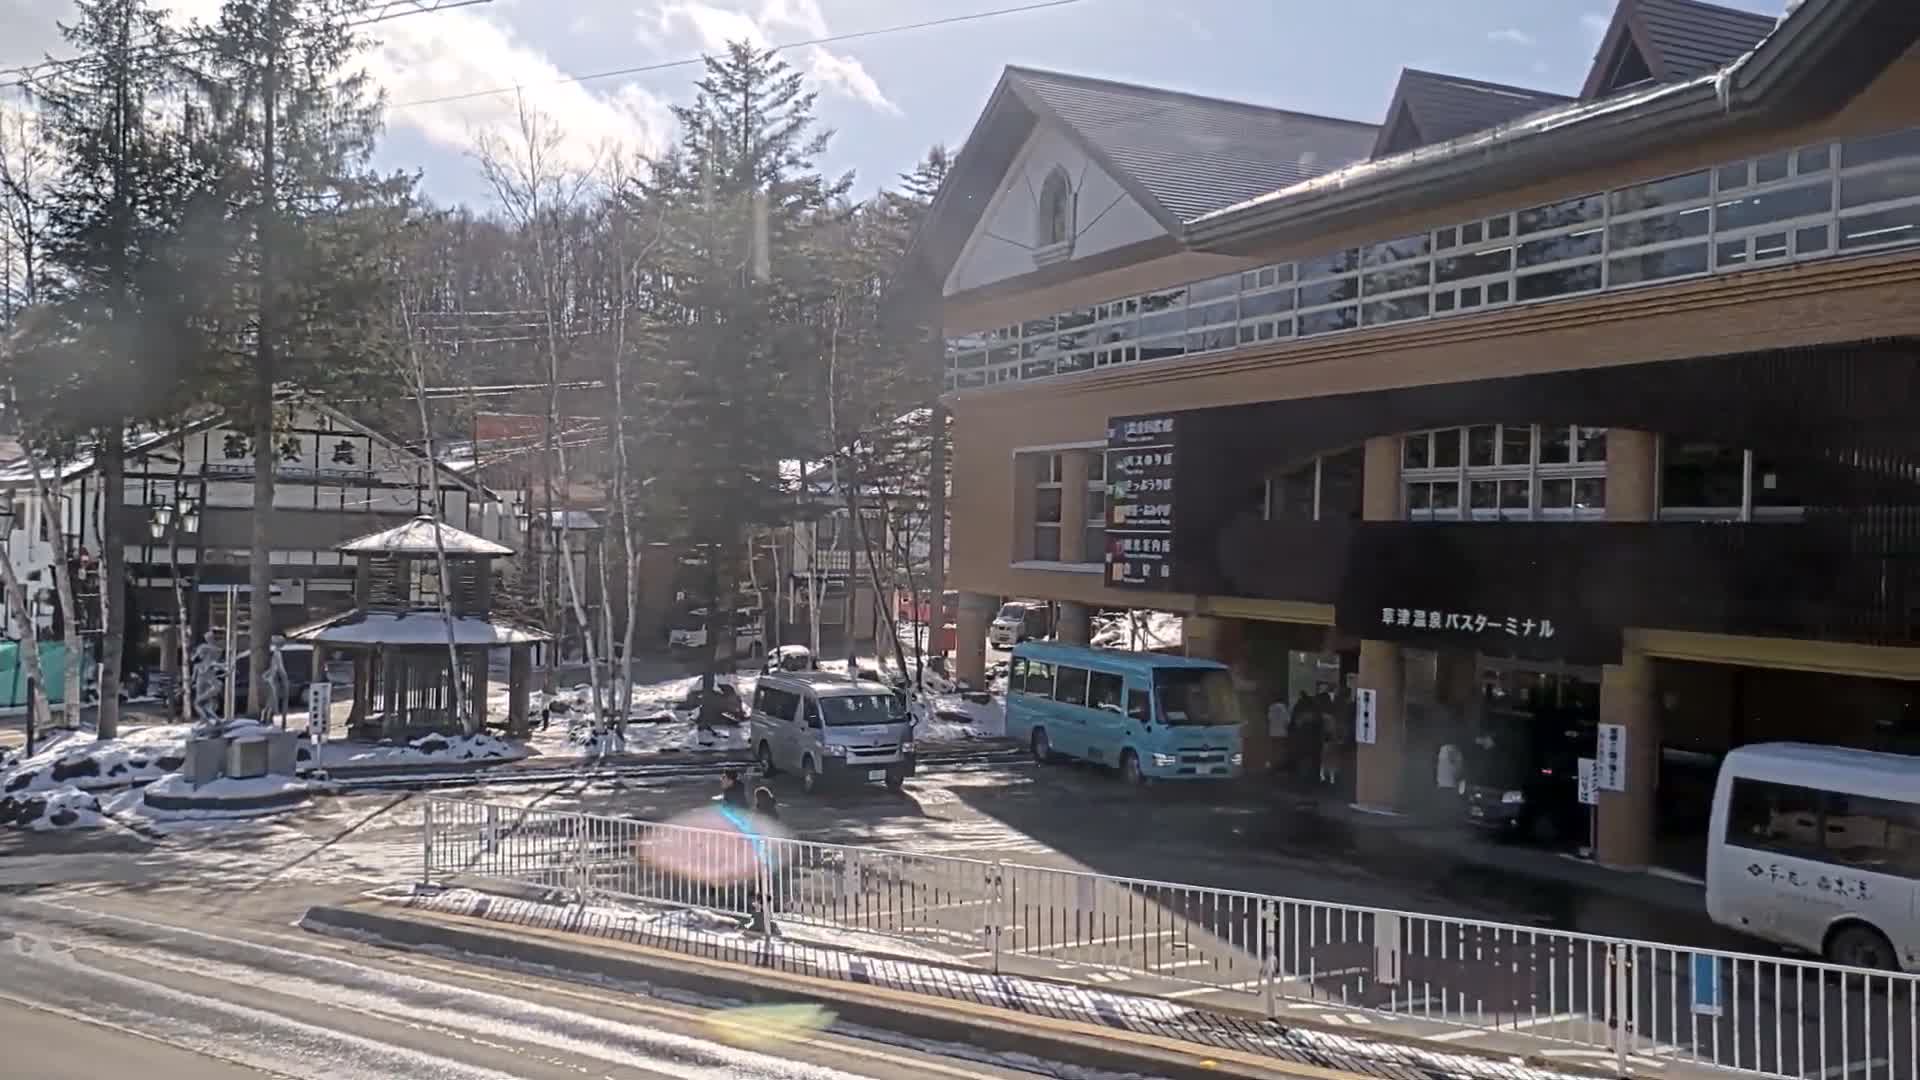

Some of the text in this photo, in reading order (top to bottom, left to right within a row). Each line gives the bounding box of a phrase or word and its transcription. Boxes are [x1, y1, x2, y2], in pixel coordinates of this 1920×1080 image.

[1382, 607, 1555, 638] 草津温泉バスターミナル
